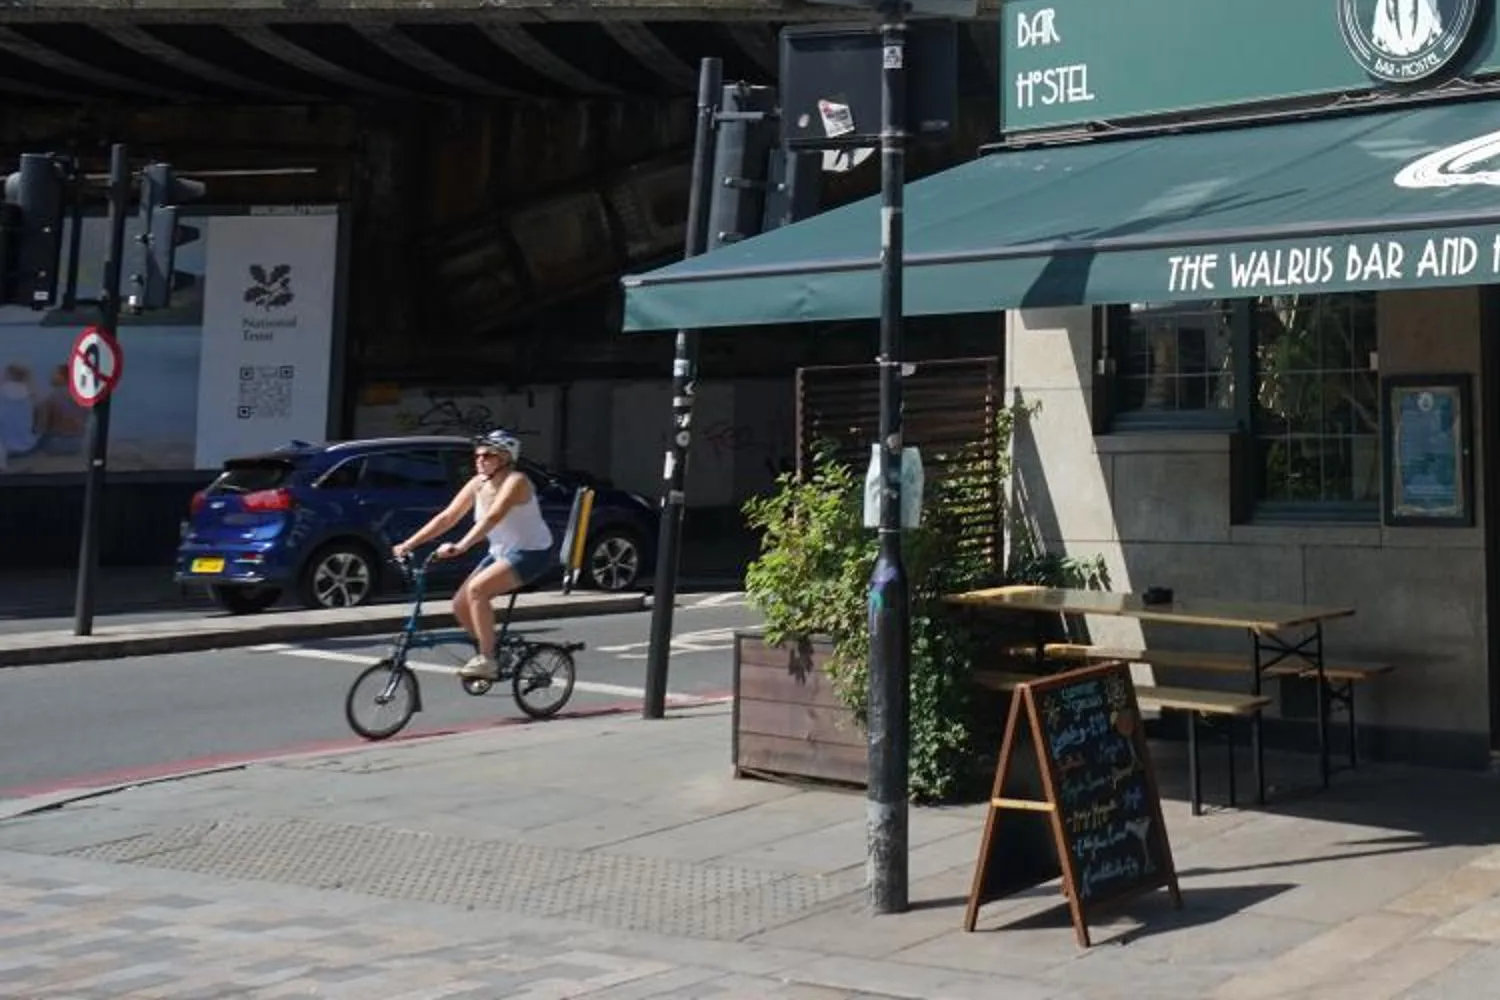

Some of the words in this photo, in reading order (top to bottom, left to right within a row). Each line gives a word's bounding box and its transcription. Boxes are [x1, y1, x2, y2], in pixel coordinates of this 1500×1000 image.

[1017, 8, 1061, 48] BAR
[1168, 253, 1218, 292] THE
[1230, 244, 1334, 288] WALRUS
[1345, 238, 1404, 281] BAR
[1416, 233, 1479, 277] AND
